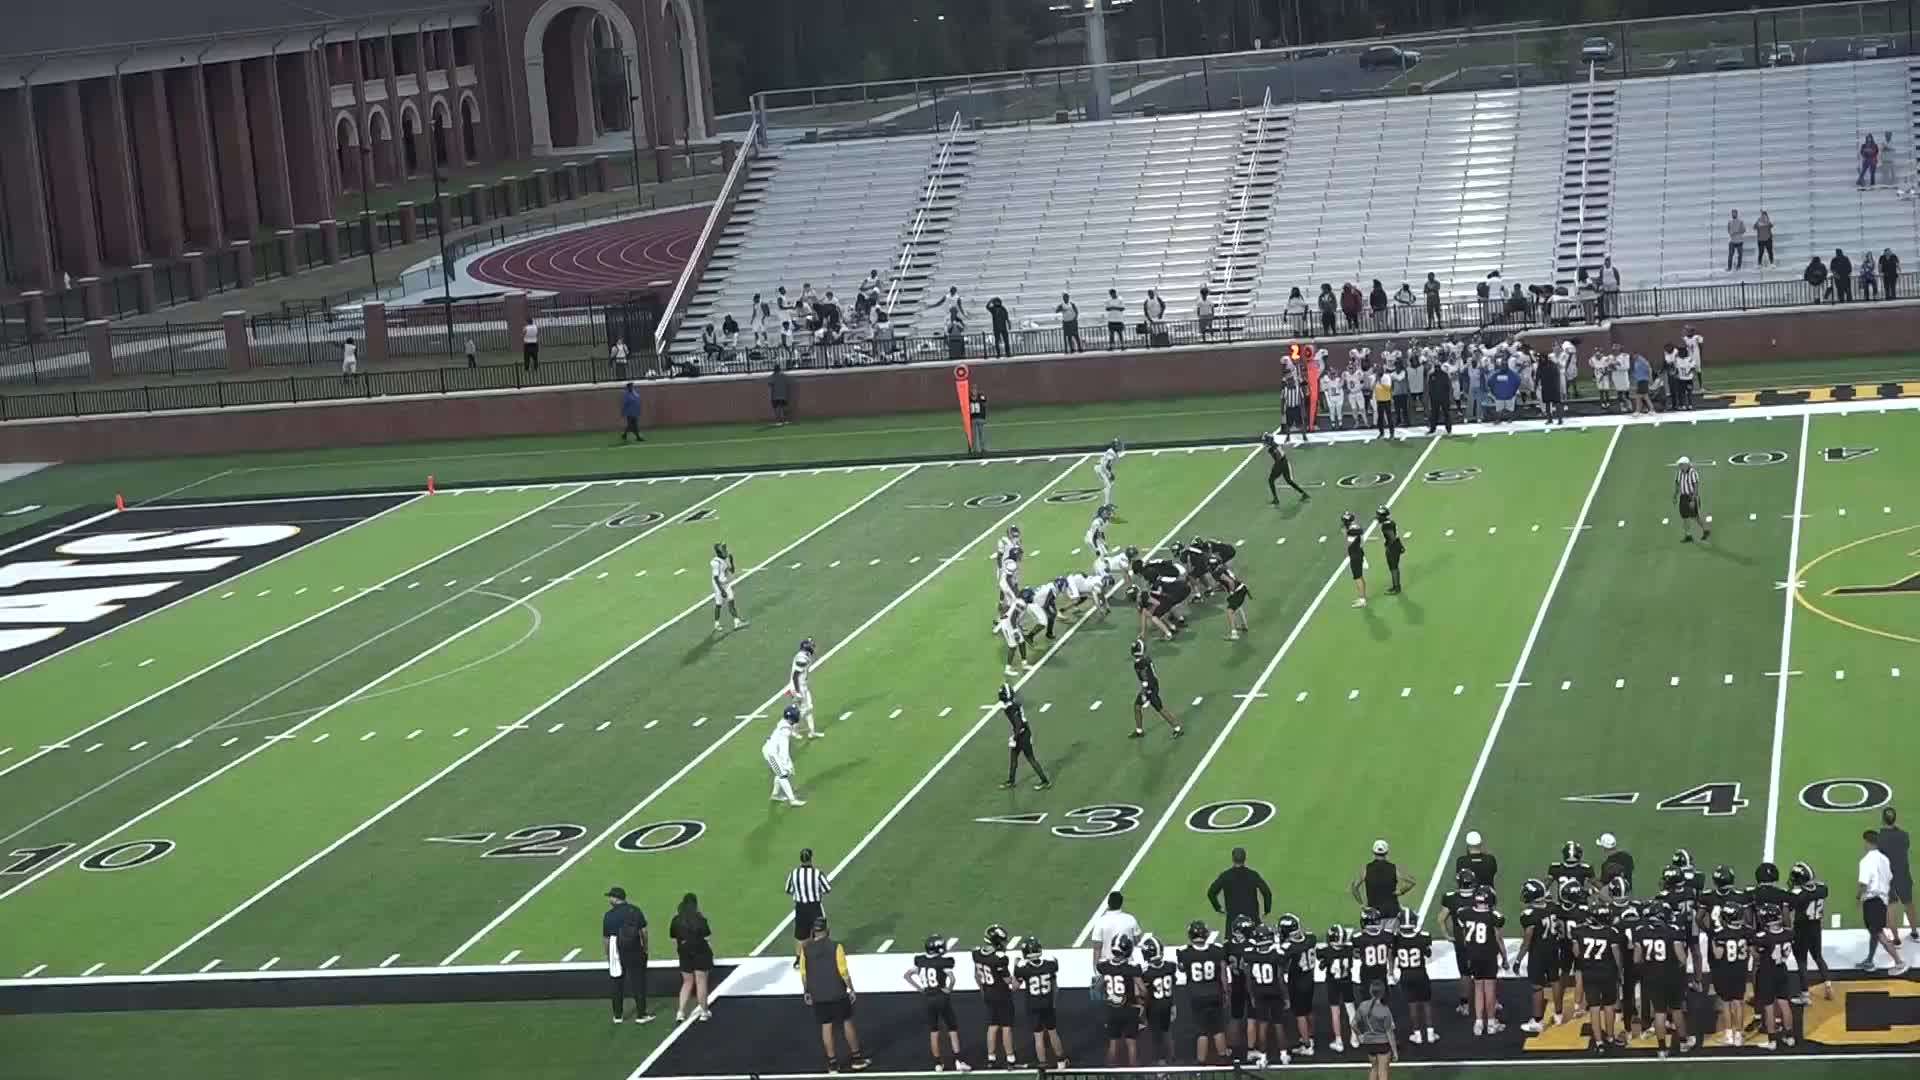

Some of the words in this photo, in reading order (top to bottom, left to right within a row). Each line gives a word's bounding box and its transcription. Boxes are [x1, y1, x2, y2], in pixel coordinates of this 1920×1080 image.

[1464, 920, 1487, 944] 78
[1365, 943, 1387, 967] 80
[1398, 948, 1421, 968] 92
[1583, 937, 1607, 960] 77
[1643, 938, 1666, 962] 79
[1191, 960, 1215, 982] 68
[1251, 962, 1273, 984] 40
[1029, 973, 1051, 996] 25
[1152, 975, 1172, 999] 39
